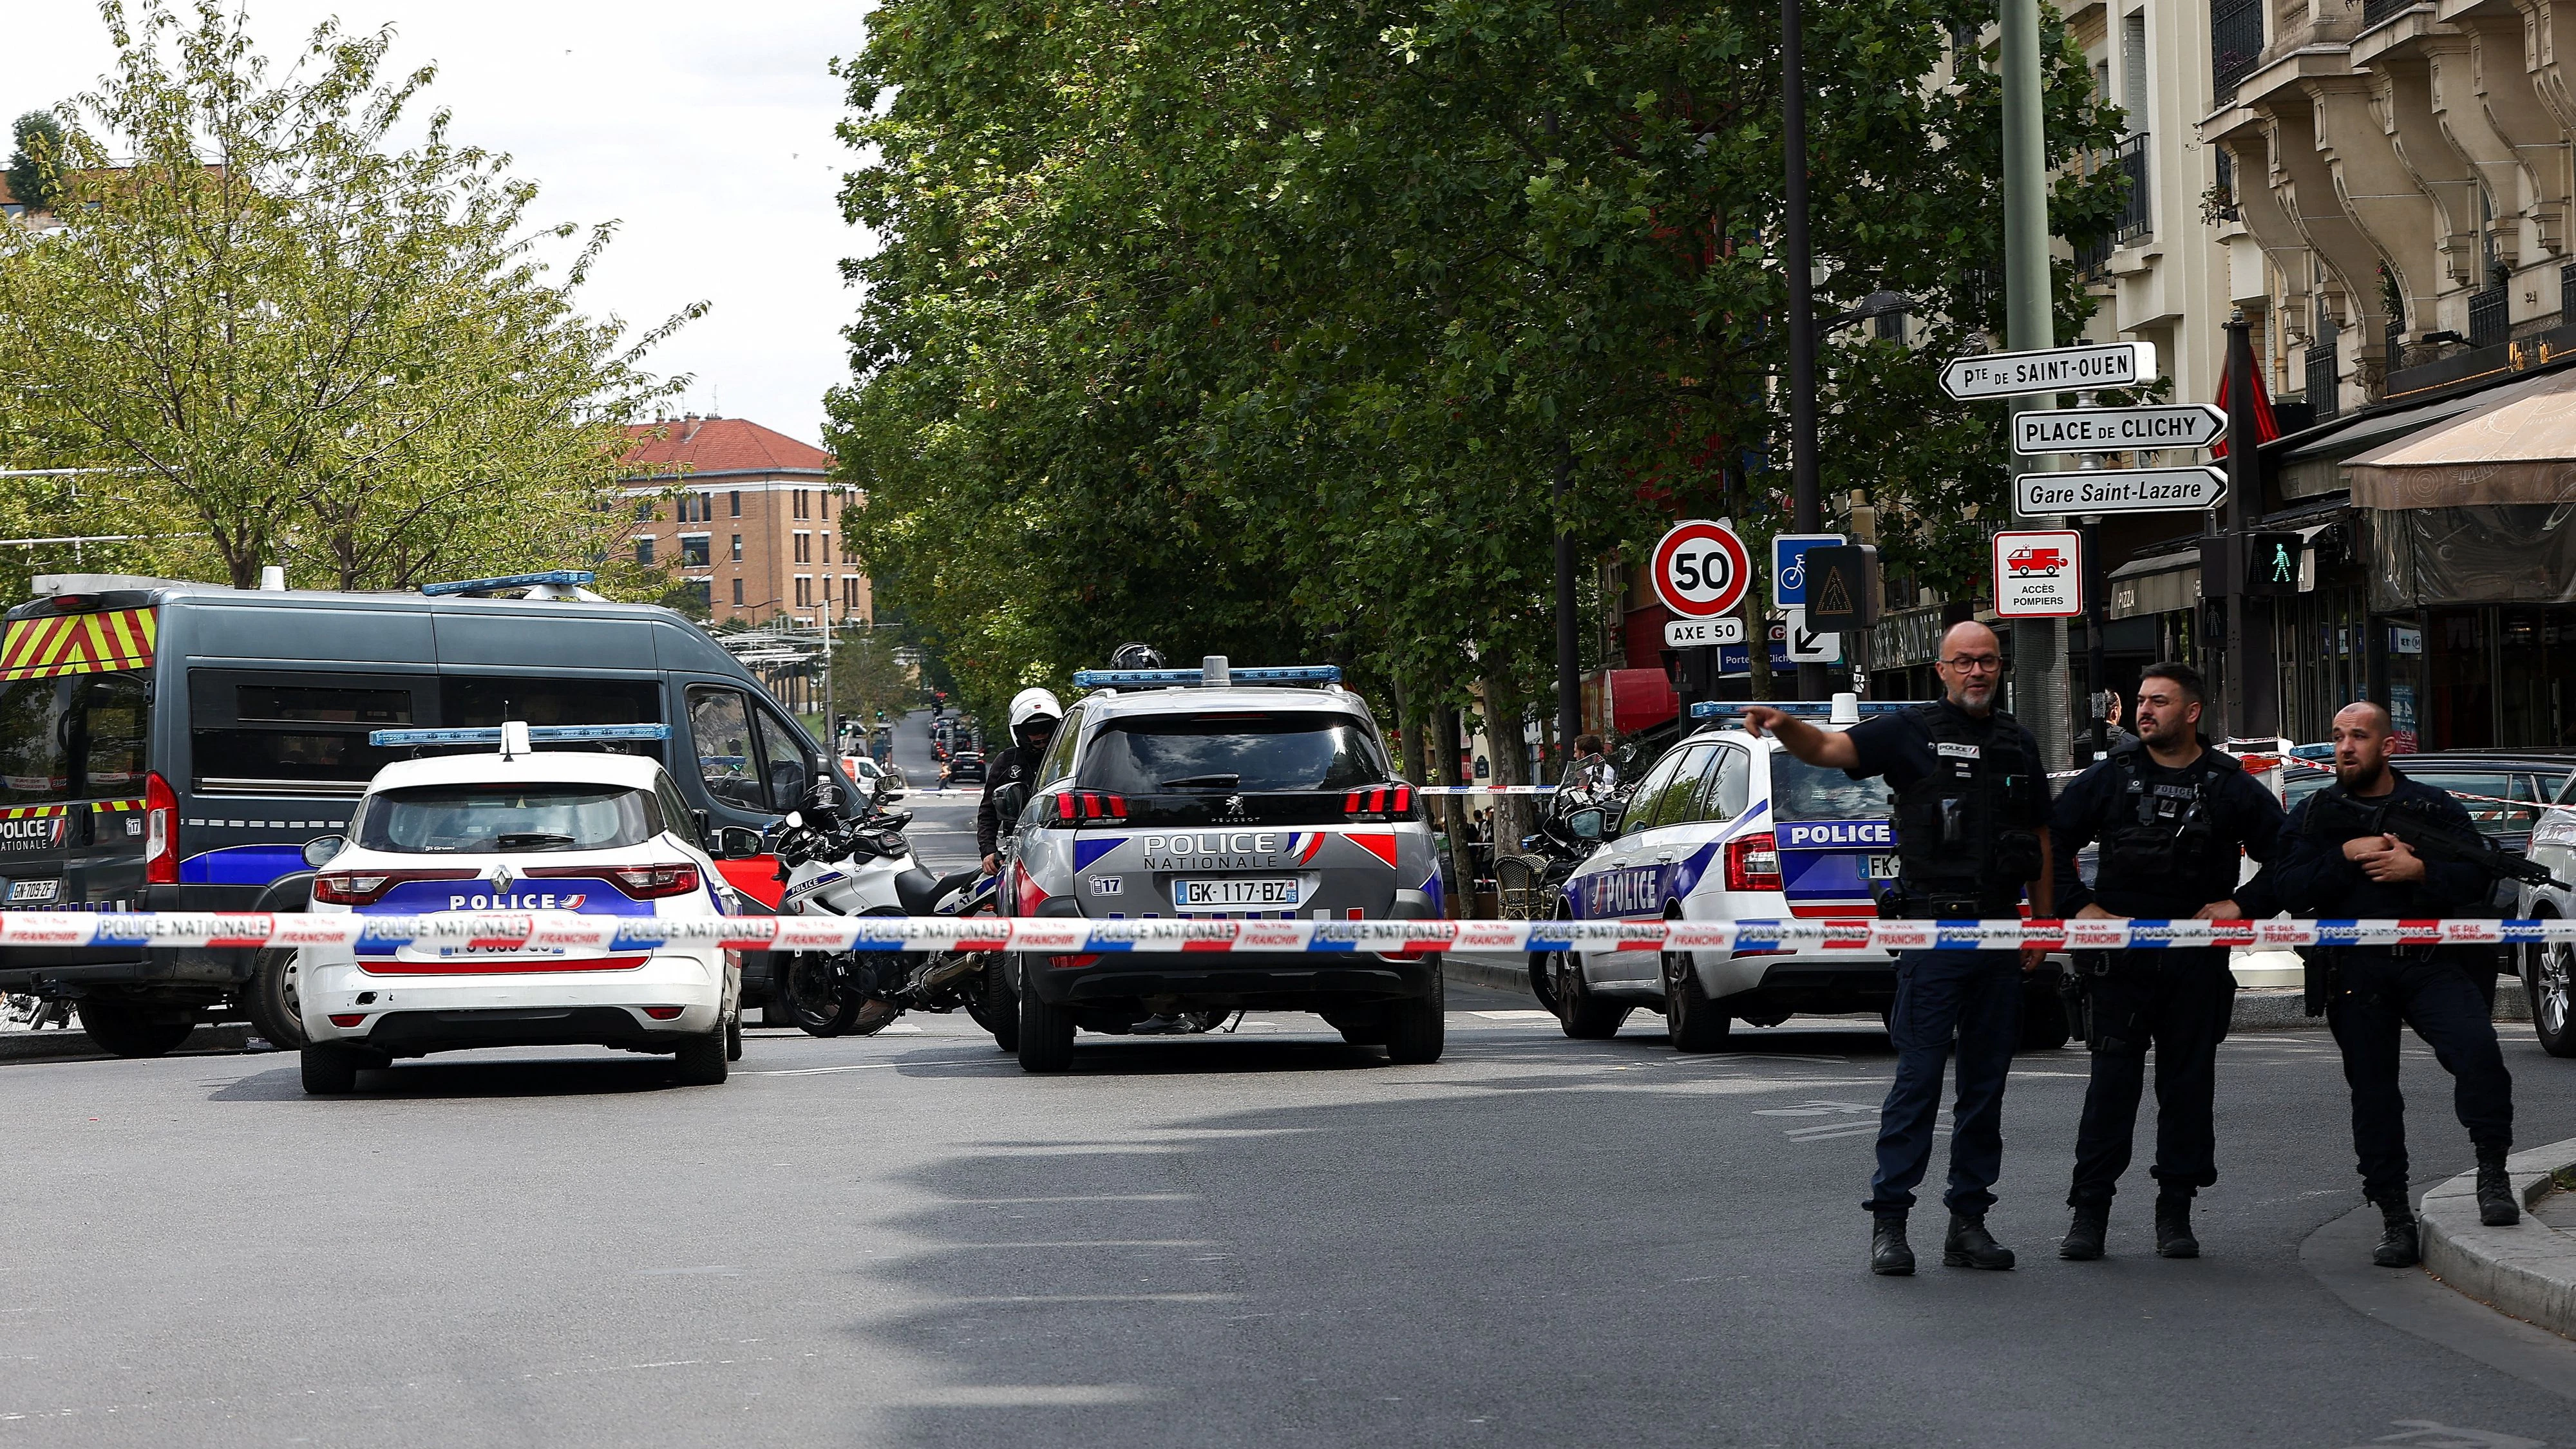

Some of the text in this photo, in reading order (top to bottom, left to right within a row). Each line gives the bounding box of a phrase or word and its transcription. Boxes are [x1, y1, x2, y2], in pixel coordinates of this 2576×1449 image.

[1995, 372, 2009, 384] DE
[2016, 355, 2128, 383] SAINT-OUEN
[2026, 416, 2197, 442] PLACE DE CLICHY
[2029, 480, 2201, 504] Gare Saint-Lazare
[1674, 551, 1730, 591] 50
[2022, 583, 2054, 594] ACCÈS
[2013, 596, 2064, 606] POMPIERS
[2117, 589, 2135, 610] PIZZA
[1674, 624, 1736, 641] AXE 50
[1726, 656, 1750, 665] Porte
[2155, 784, 2192, 796] POLICE
[131, 822, 138, 832] 17
[1792, 824, 1891, 844] POLICE
[1, 839, 47, 851] ATIONALE
[1143, 833, 1276, 857] POLICE
[1144, 855, 1277, 870] NATIONALE
[1871, 858, 1899, 876] FK-
[791, 878, 819, 895] POLICE
[1102, 879, 1120, 893] 17
[1189, 882, 1286, 903] GK-117-BZ
[1607, 871, 1656, 912] POLICE
[450, 894, 556, 911] POLICE
[959, 894, 971, 906] 17
[101, 919, 268, 938] POLICE NATIONALE
[367, 920, 527, 938] POLICE NATIONALE
[621, 920, 773, 938] POLICE NATIONALE
[862, 921, 918, 940] POLICE
[922, 921, 1008, 940] NATIONALE
[1092, 922, 1235, 940] POLICE NATIONALE
[1316, 922, 1454, 940] POLICE NATIONALE
[1531, 923, 1664, 941] POLICE NATIONALE
[1243, 933, 1300, 946] FRANCHIR
[1461, 933, 1517, 946] FRANCHIR
[1674, 934, 1725, 945] FRANCHIR
[1877, 933, 1927, 945] FRANCHIR
[2074, 933, 2122, 944] FRANCHIR
[2264, 932, 2311, 943] FRANCHIR
